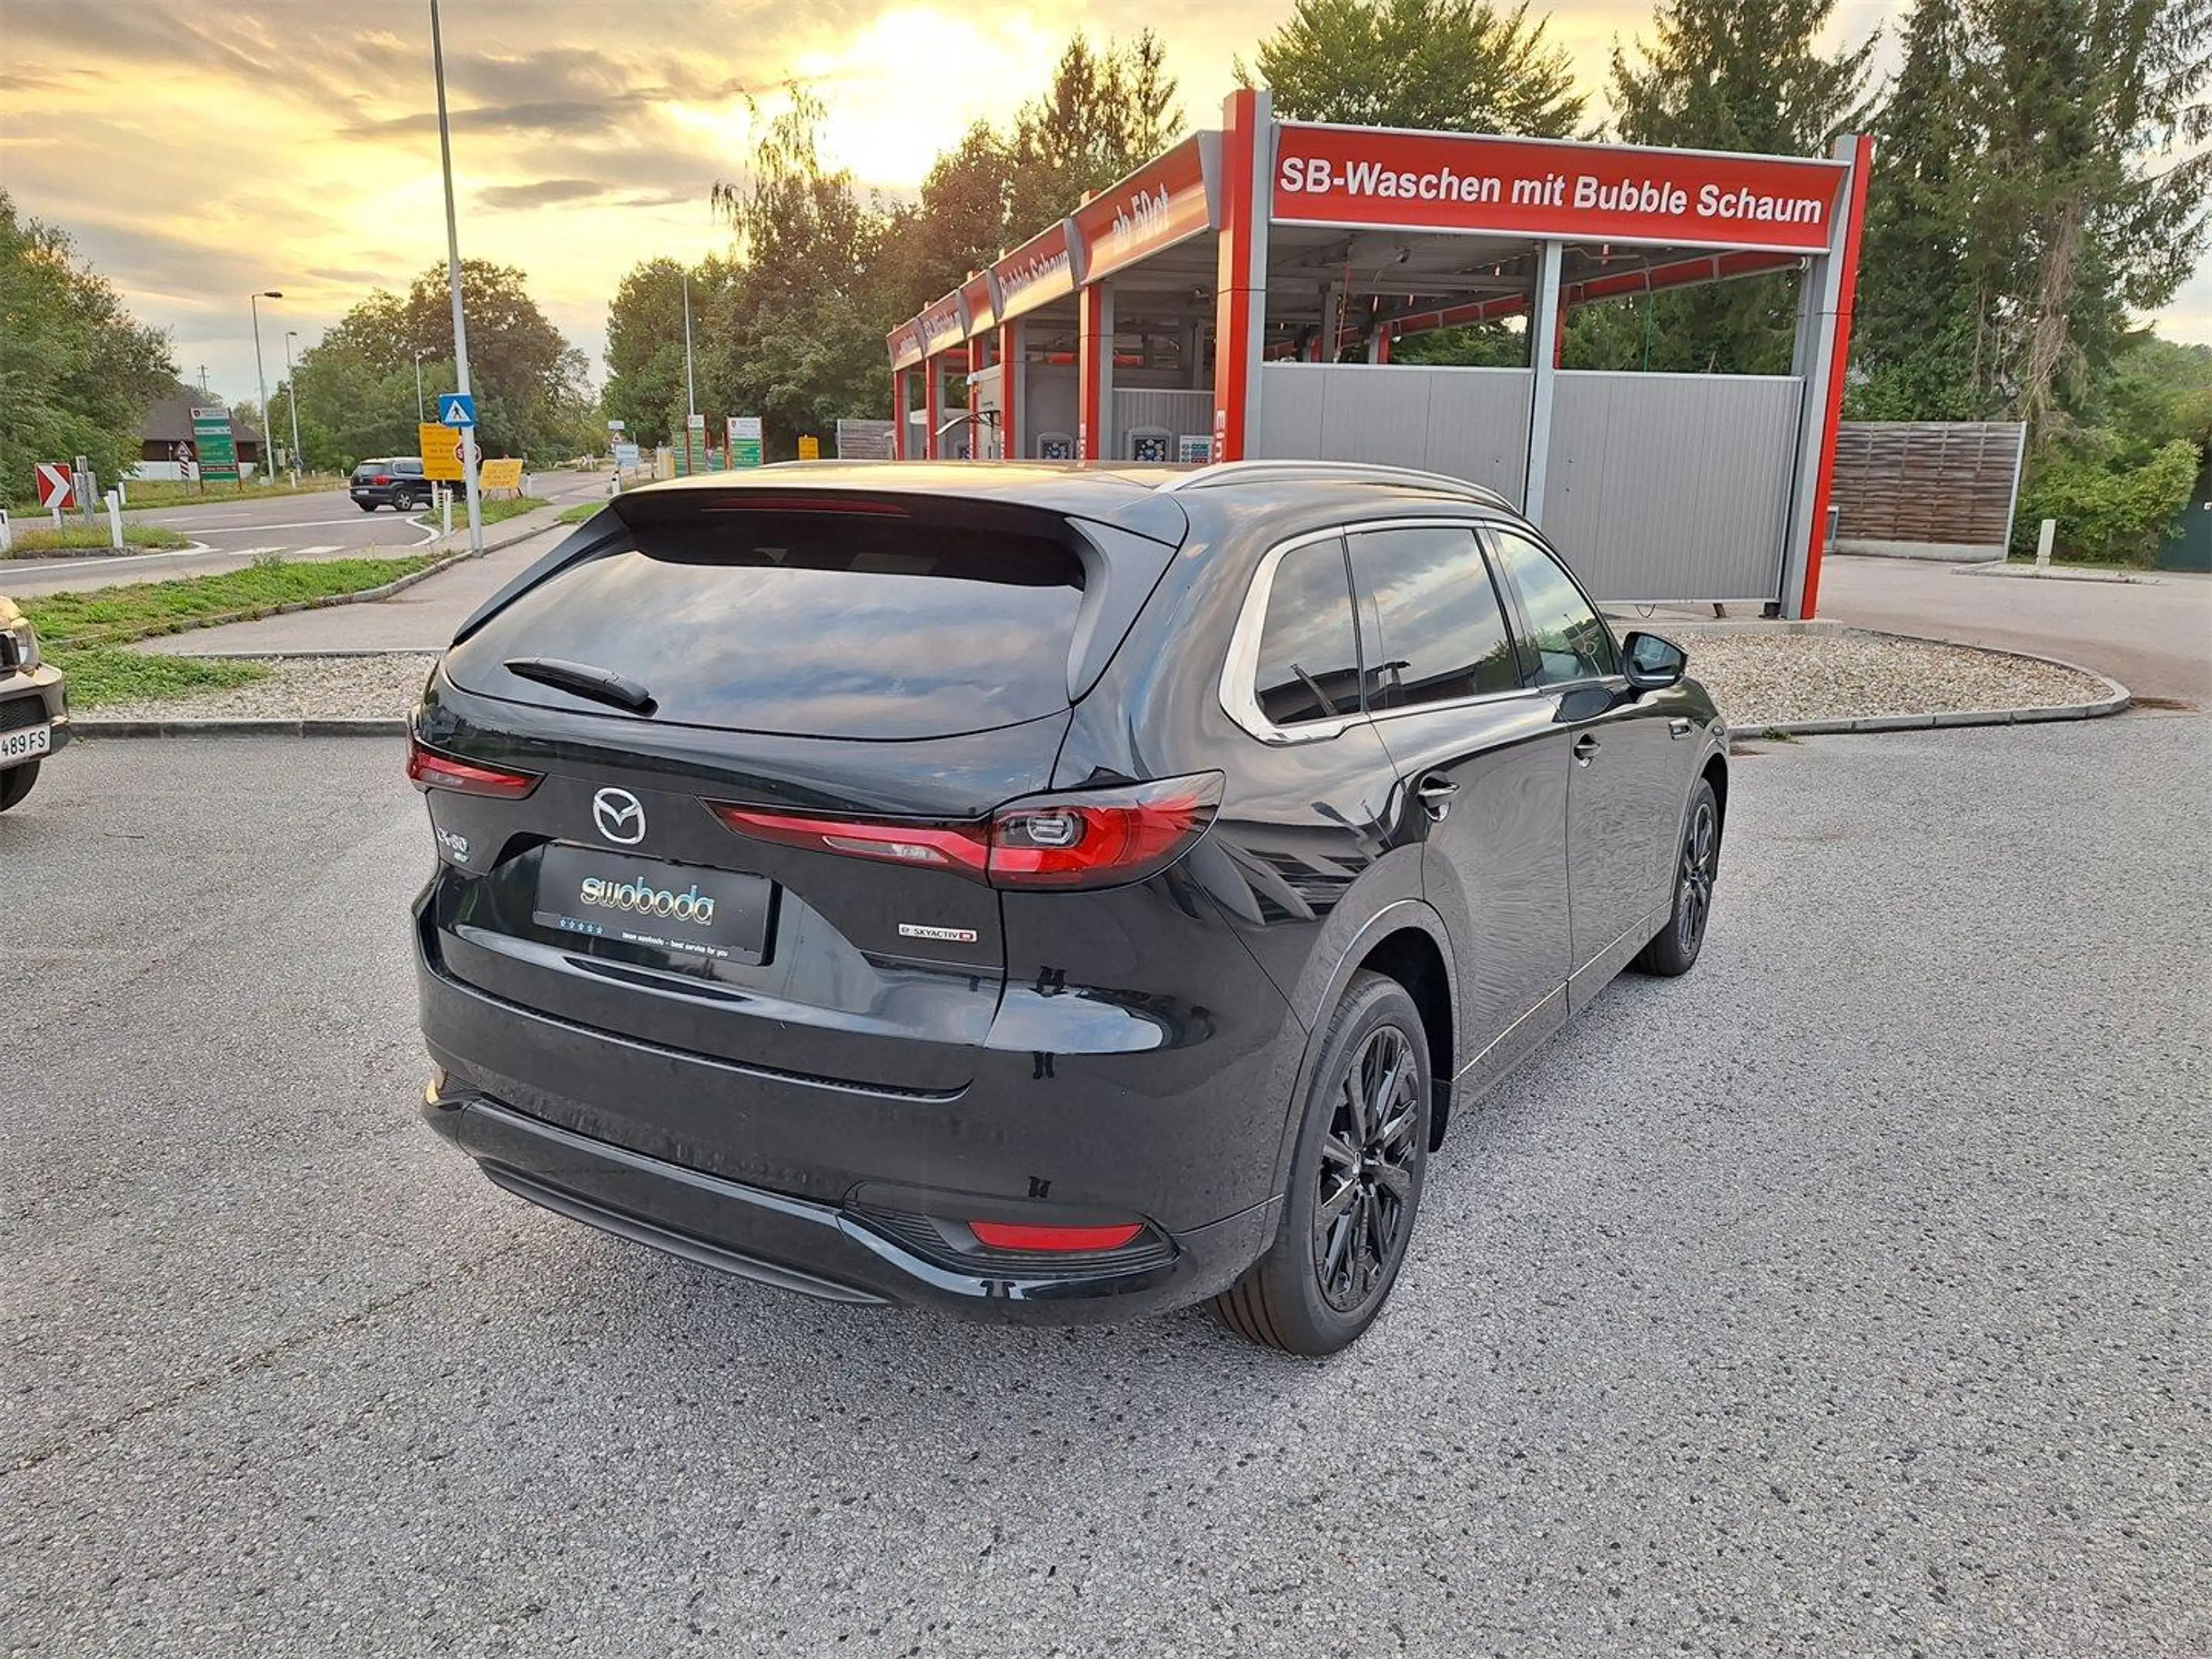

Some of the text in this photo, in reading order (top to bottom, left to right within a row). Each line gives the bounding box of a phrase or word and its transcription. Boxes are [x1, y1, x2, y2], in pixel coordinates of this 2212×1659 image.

[1280, 157, 1822, 224] SB-Waschen mit Bubble Schaum
[581, 876, 715, 926] swoboda
[914, 928, 958, 938] SKYACTIV
